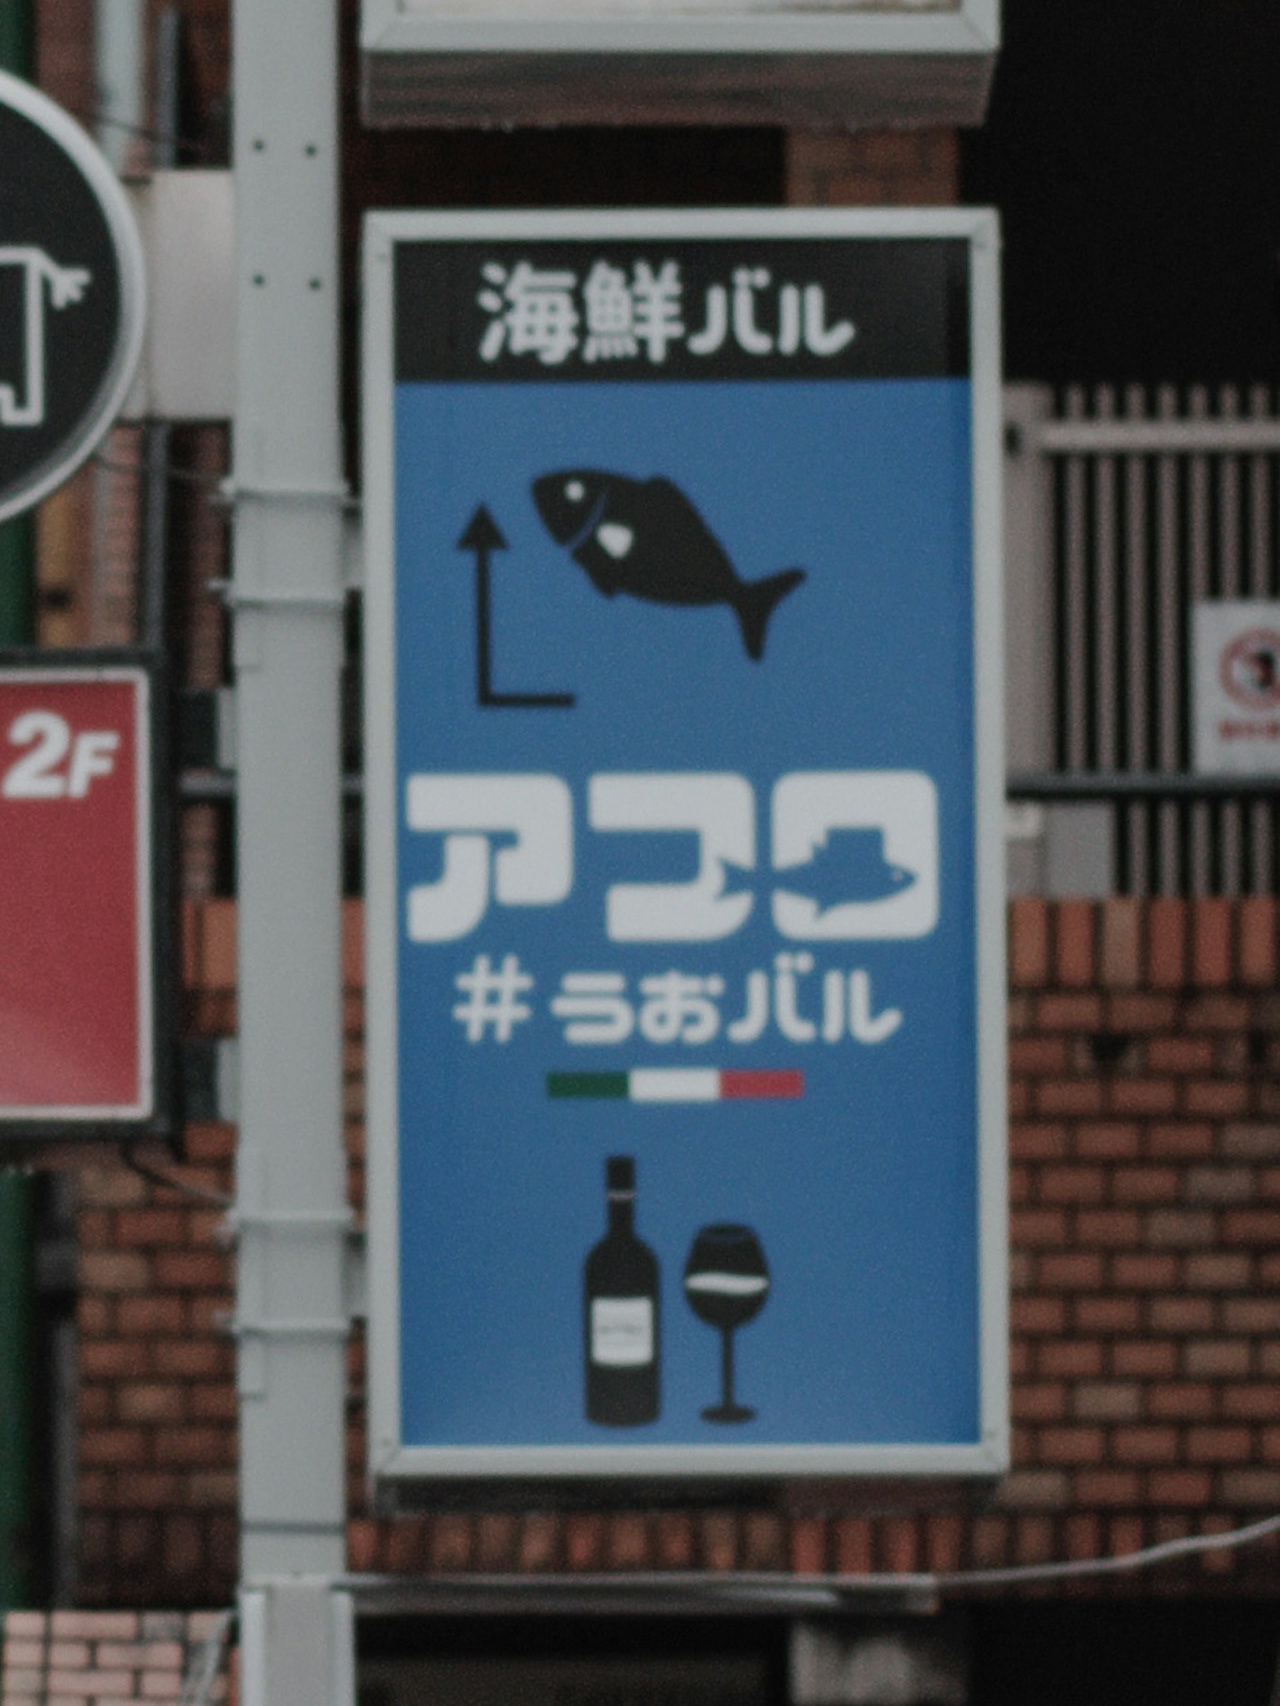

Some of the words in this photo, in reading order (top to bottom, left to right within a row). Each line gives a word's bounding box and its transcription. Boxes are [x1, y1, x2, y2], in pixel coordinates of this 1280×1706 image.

[477, 260, 857, 364] 海鮮バル
[2, 708, 121, 799] 2F
